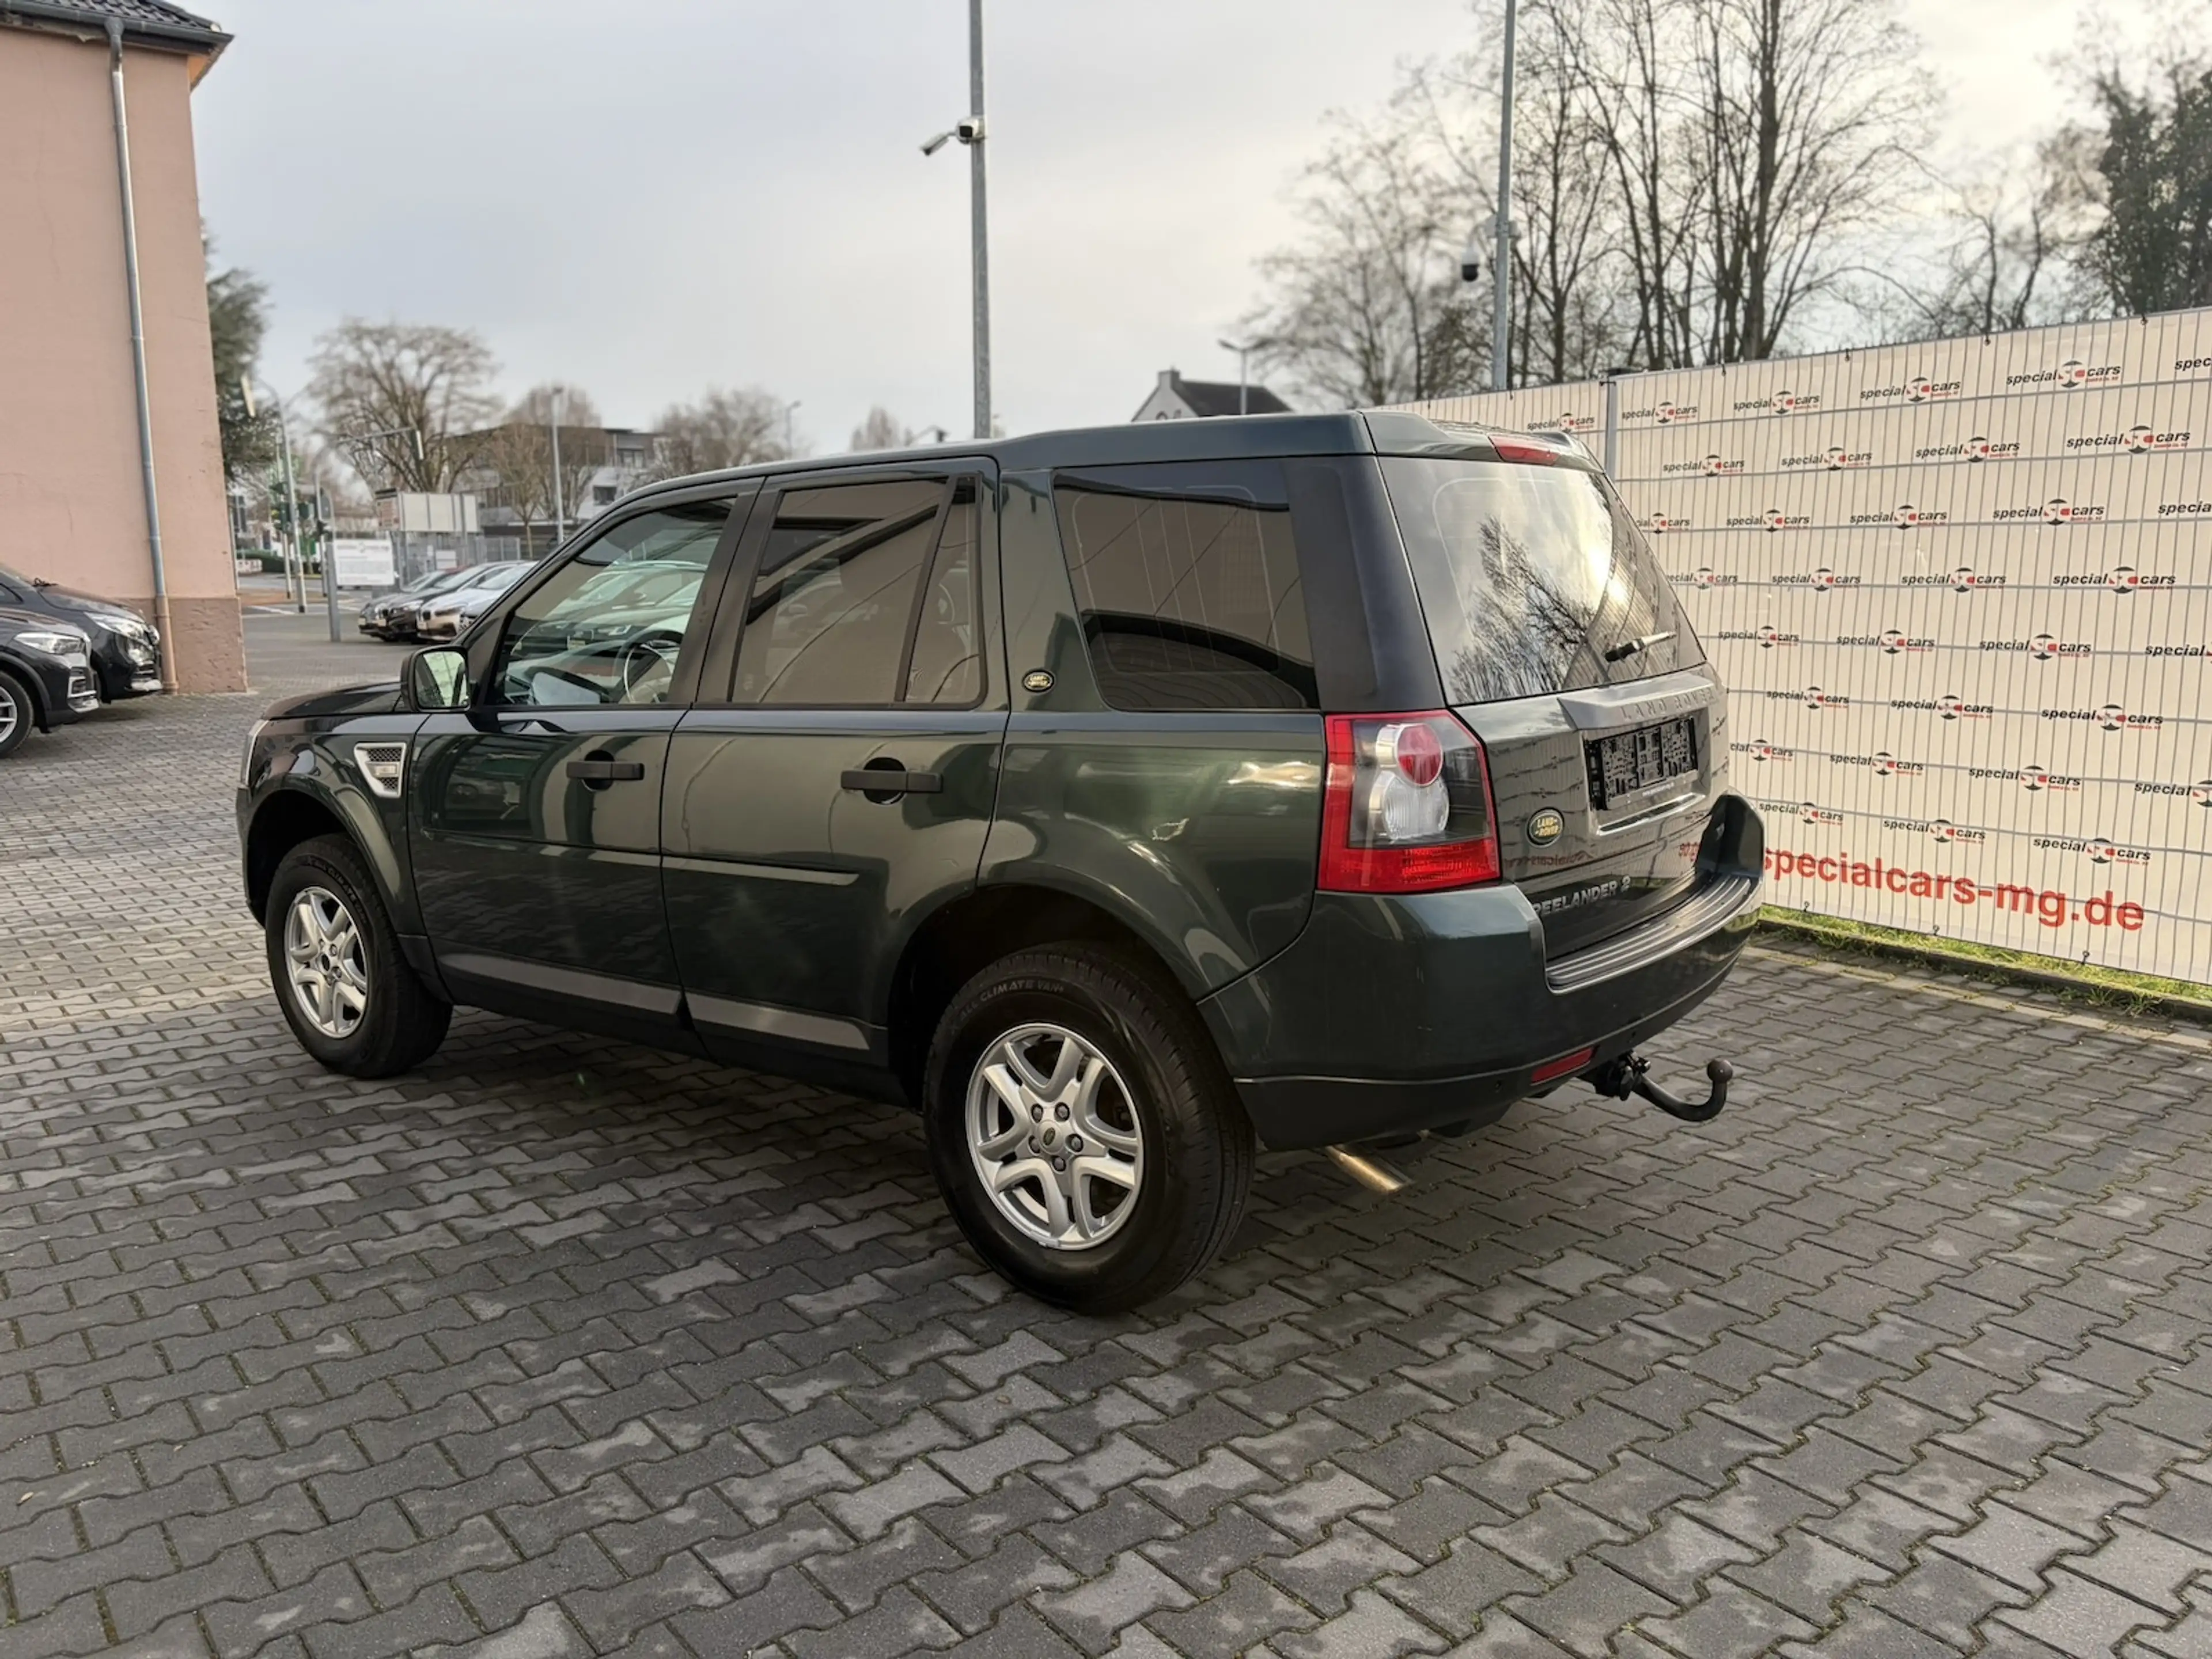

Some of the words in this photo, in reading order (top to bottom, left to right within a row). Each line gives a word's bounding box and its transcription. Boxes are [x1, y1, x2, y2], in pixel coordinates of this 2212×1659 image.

[2006, 369, 2058, 386] special
[2087, 366, 2121, 378] cars
[1860, 384, 1907, 400] special
[1931, 381, 1960, 392] cars
[1733, 396, 1772, 411] special
[1794, 395, 1819, 405] cars
[1622, 407, 1656, 420] special
[1675, 406, 1698, 415] cars
[1527, 418, 1560, 431] special
[1575, 417, 1595, 426] cars
[2067, 434, 2124, 449] special
[2156, 432, 2191, 444] cars
[1916, 444, 1963, 459] special
[1991, 442, 2020, 453] cars
[1663, 460, 1702, 472] special
[1722, 460, 1744, 469] cars
[1781, 453, 1824, 467] special
[1848, 452, 1872, 462] cars
[1850, 512, 1895, 525] special
[1918, 513, 1946, 521] cars
[1993, 506, 2043, 520] special
[2071, 507, 2104, 516] cars
[1726, 515, 1763, 527] special
[1716, 575, 1738, 583] cars
[1772, 574, 1812, 584] special
[1835, 576, 1861, 584] cars
[1902, 573, 1951, 586] special
[1976, 575, 2006, 584] cars
[2054, 573, 2108, 586] special
[2141, 575, 2176, 584] cars
[1717, 631, 1758, 640] special
[1777, 634, 1799, 642] cars
[1836, 635, 1881, 646] special
[1906, 638, 1934, 648] cars
[1979, 639, 2030, 651] special
[2058, 643, 2091, 653] cars
[2145, 645, 2205, 657] special
[1766, 691, 1805, 700] special
[1824, 695, 1850, 704] cars
[1891, 700, 1937, 710] special
[1964, 705, 1993, 714] cars
[2041, 710, 2096, 720] special
[2128, 715, 2163, 724] cars
[1771, 747, 1794, 757] cars
[1830, 754, 1872, 766] special
[1896, 762, 1923, 771] cars
[1969, 768, 2020, 780] special
[2048, 775, 2081, 787] cars
[2134, 782, 2192, 796] special
[1759, 801, 1800, 815] special
[1820, 812, 1843, 822] cars
[1884, 820, 1930, 832] special
[1956, 830, 1985, 840] cars
[2034, 839, 2088, 853] special
[2117, 850, 2150, 863] cars
[980, 979, 1036, 1002] CLIMATE
